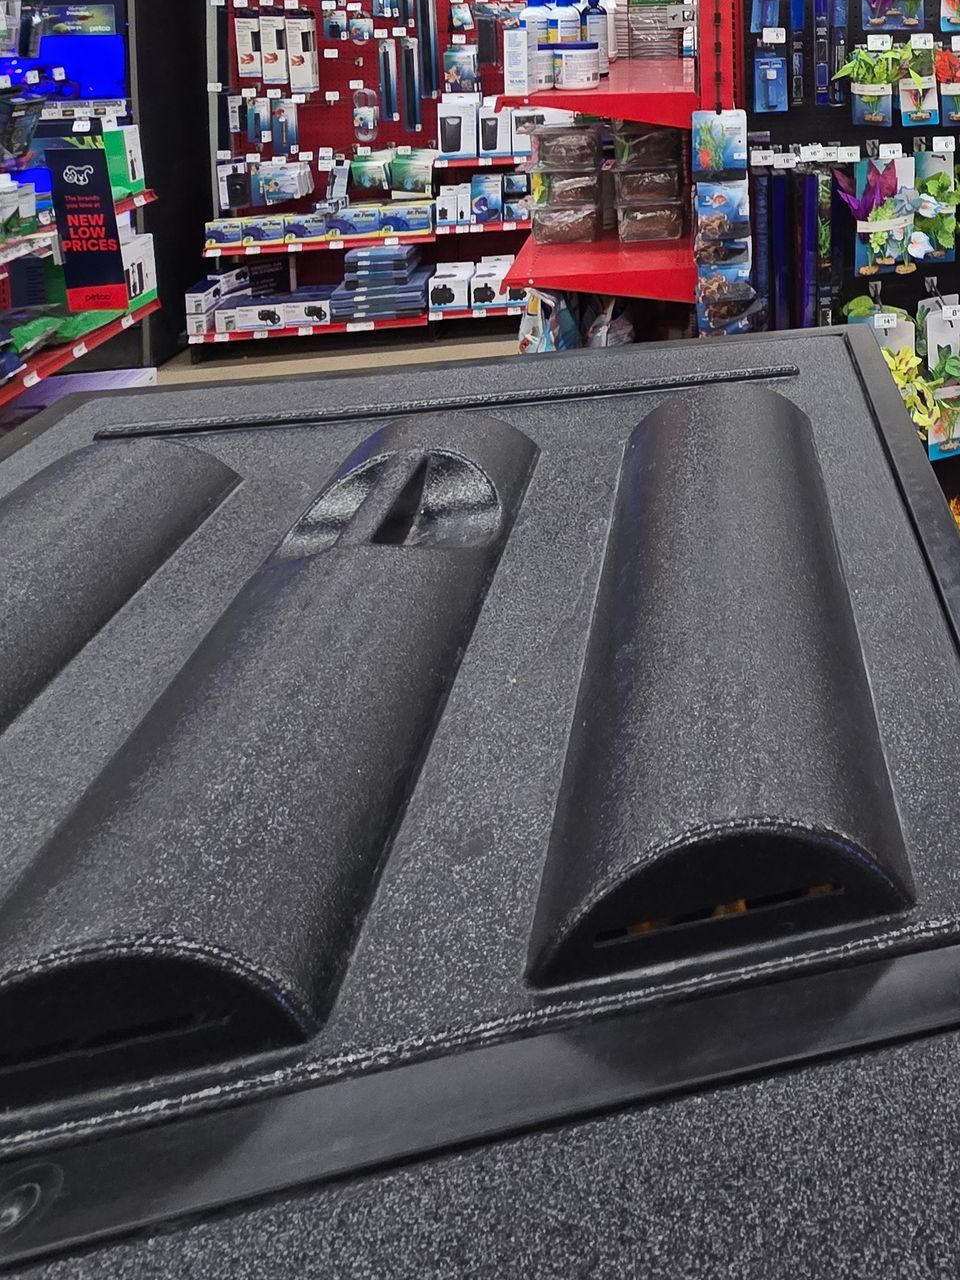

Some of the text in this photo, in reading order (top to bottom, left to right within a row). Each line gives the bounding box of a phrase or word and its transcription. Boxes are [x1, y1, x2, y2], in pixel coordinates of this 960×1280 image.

[67, 214, 104, 226] NEW
[69, 227, 106, 238] LOW
[62, 239, 117, 251] PRICES
